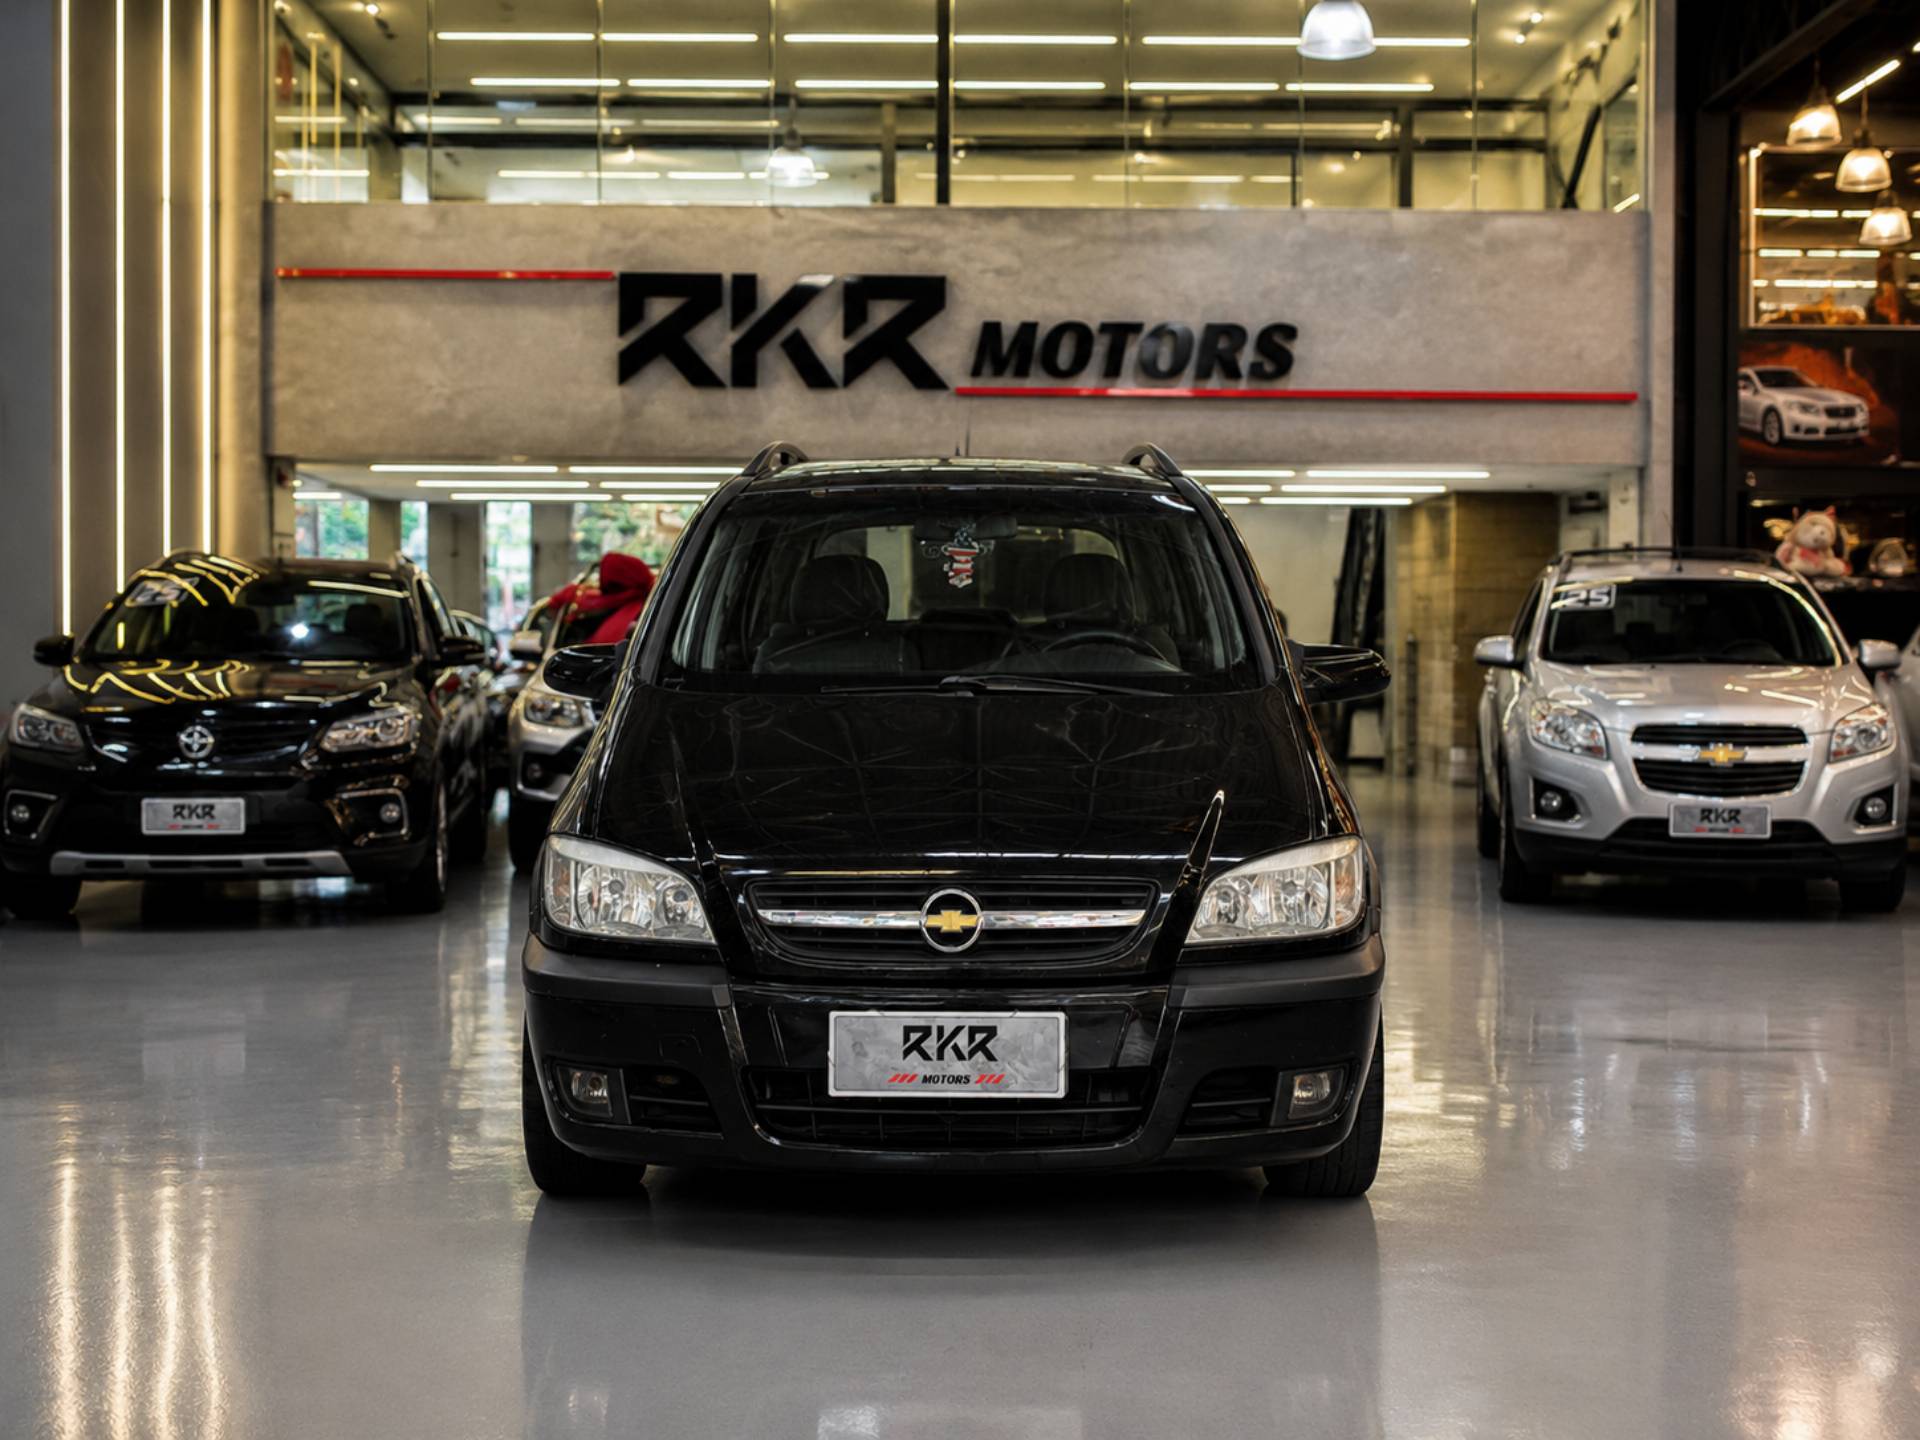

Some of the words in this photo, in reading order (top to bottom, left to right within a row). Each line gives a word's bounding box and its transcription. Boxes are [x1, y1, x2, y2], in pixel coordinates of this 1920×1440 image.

[618, 272, 951, 389] RKR
[970, 321, 1299, 380] MOTORS
[172, 803, 216, 820] RKR
[1700, 808, 1742, 824] RKR
[902, 1025, 999, 1062] RKR
[921, 1074, 971, 1085] MOTORS
